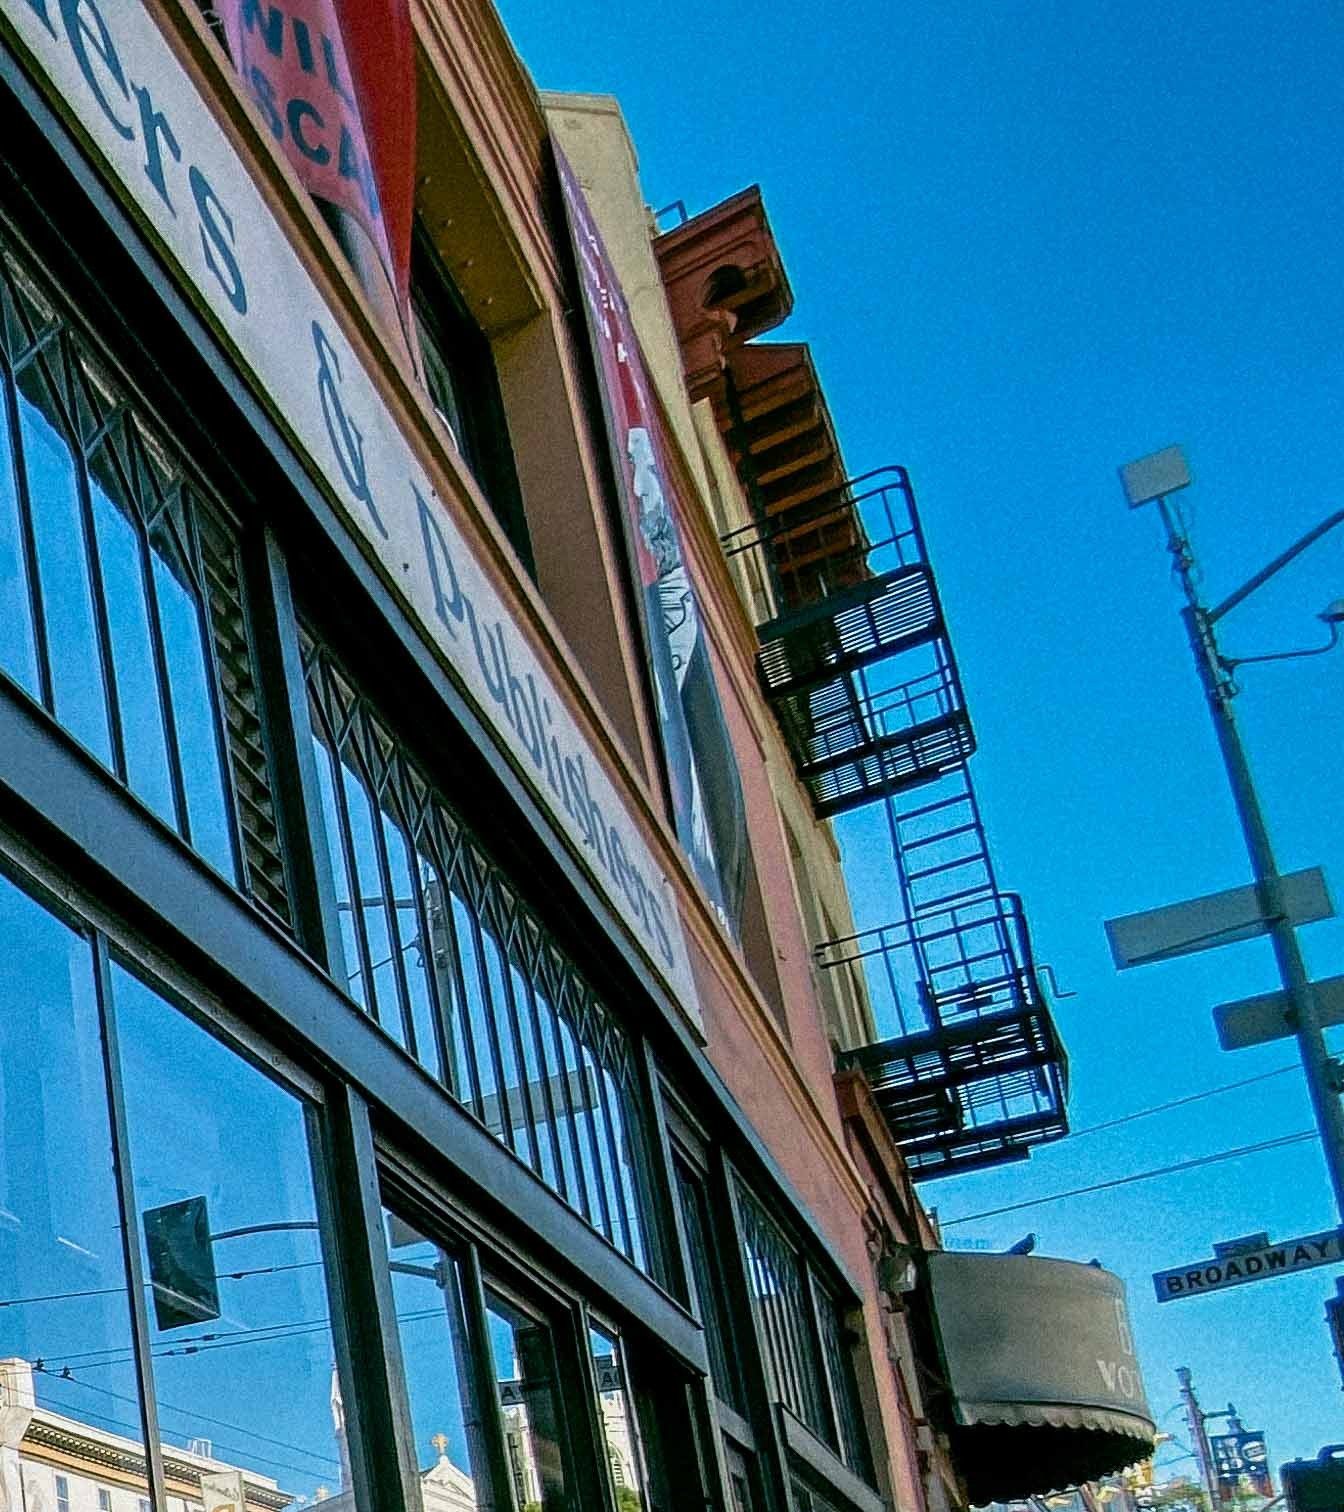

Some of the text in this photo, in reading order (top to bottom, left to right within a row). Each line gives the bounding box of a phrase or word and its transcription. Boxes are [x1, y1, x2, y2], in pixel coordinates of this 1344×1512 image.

[311, 319, 390, 540] &
[412, 482, 678, 971] Publishers
[1166, 1238, 1330, 1294] BROADWAY
